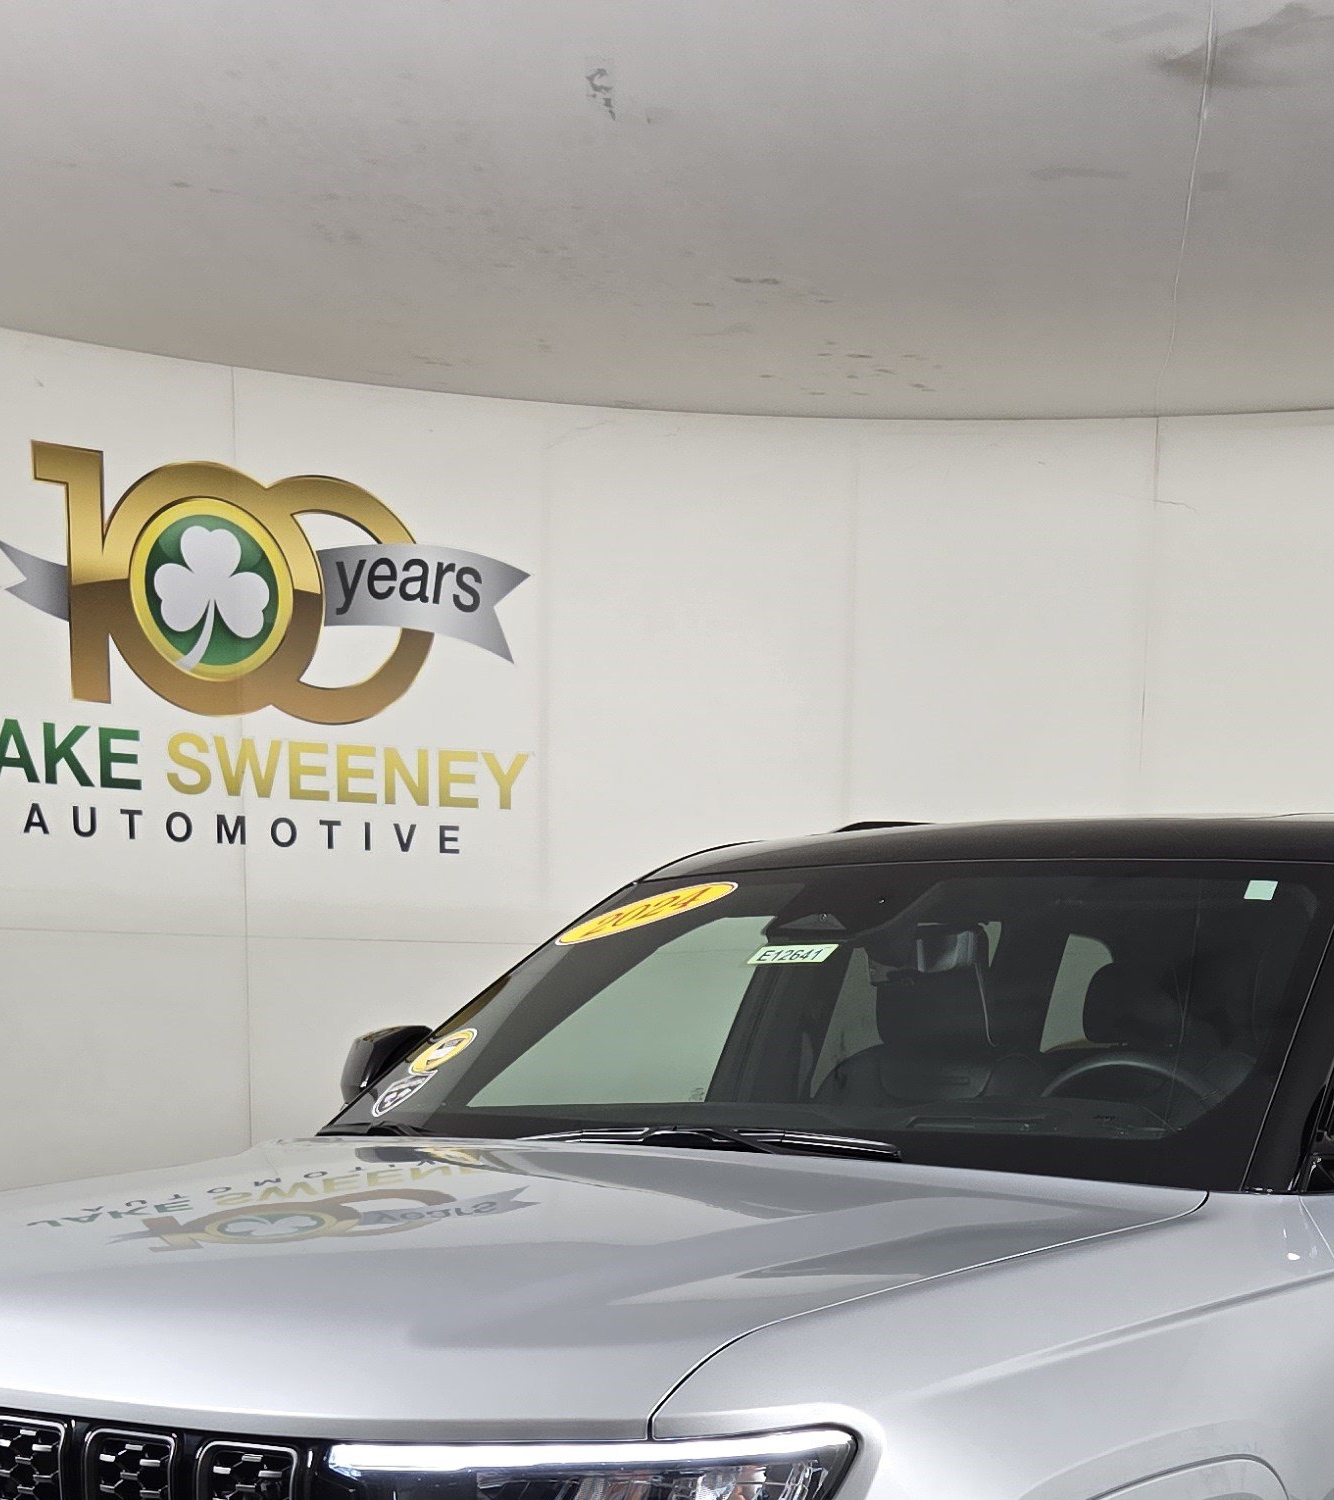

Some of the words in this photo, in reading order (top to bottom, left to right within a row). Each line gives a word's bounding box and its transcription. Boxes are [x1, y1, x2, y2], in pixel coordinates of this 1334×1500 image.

[30, 440, 434, 724] 100
[335, 557, 483, 613] years
[167, 732, 531, 809] SWEENEY
[23, 803, 461, 854] AUTOMOTIVE
[579, 886, 712, 938] 2024
[758, 946, 824, 962] E12641
